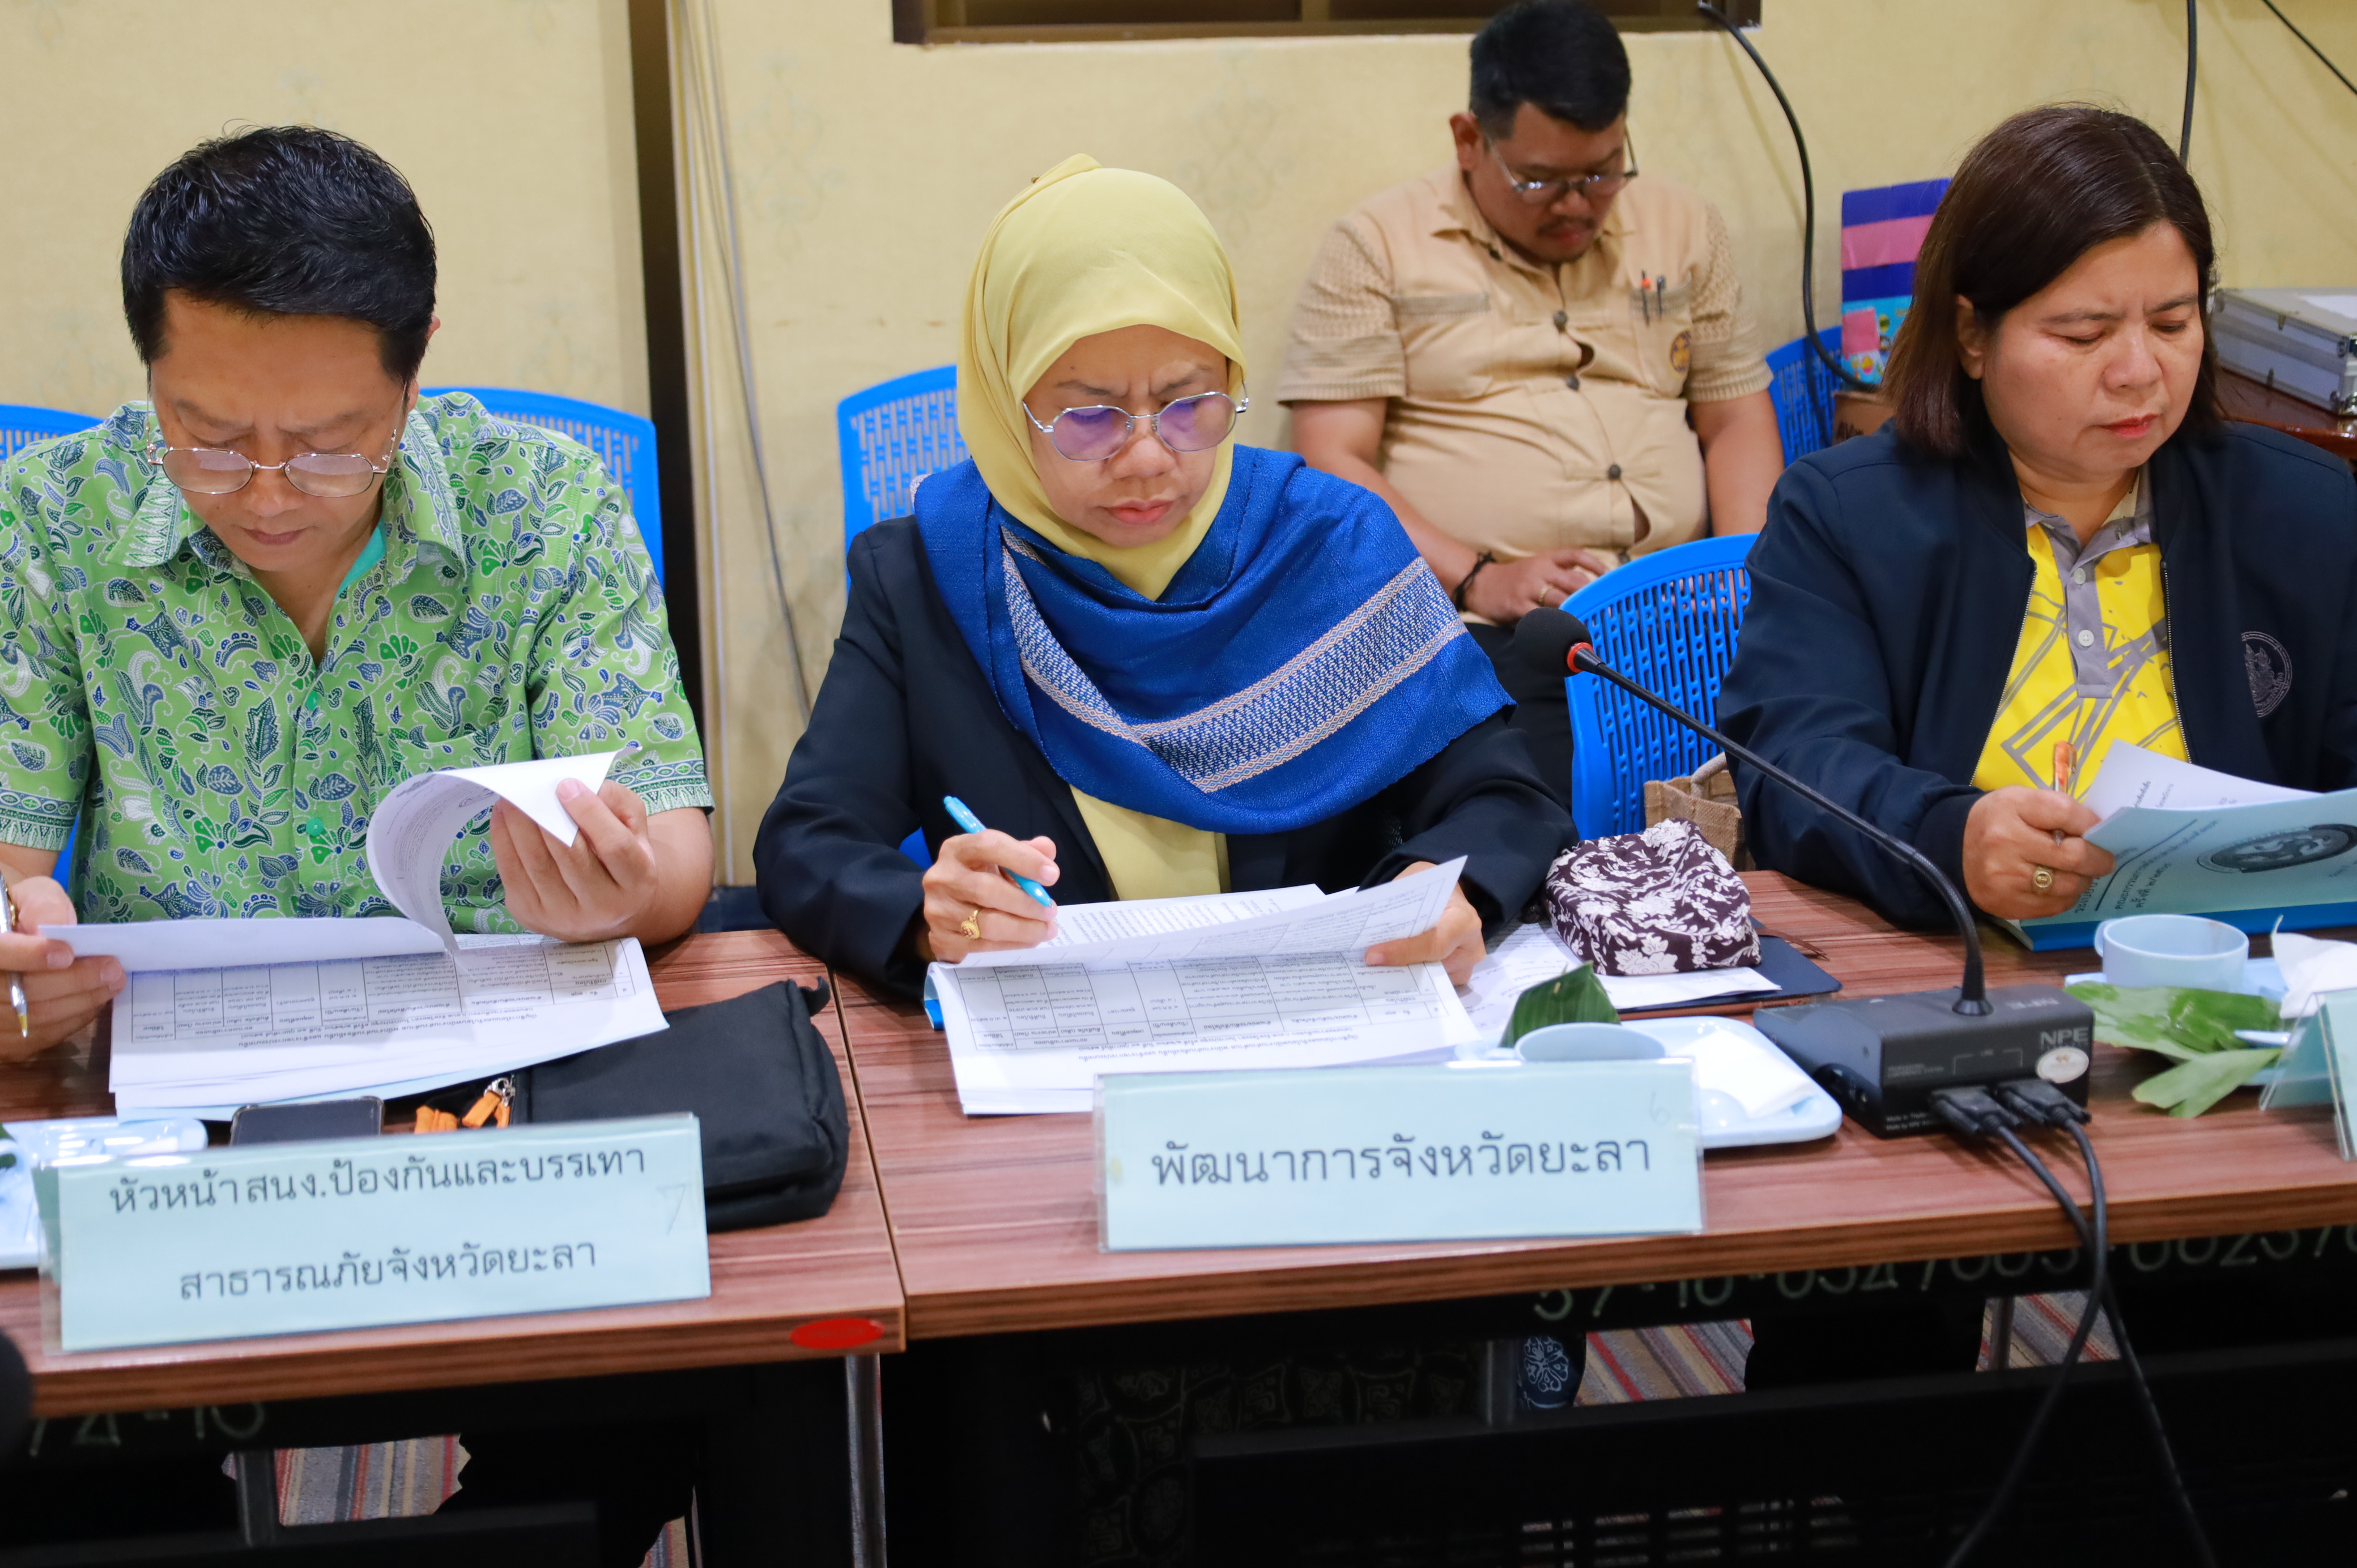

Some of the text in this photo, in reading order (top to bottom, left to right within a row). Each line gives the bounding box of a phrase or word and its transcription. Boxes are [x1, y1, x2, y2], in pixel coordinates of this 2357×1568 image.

[2041, 1027, 2089, 1047] NPE
[1152, 1131, 1650, 1186] พัฒนาการจังหวัดยะลา
[181, 1242, 595, 1300] สาธารณภัยจังหวัดยะลา
